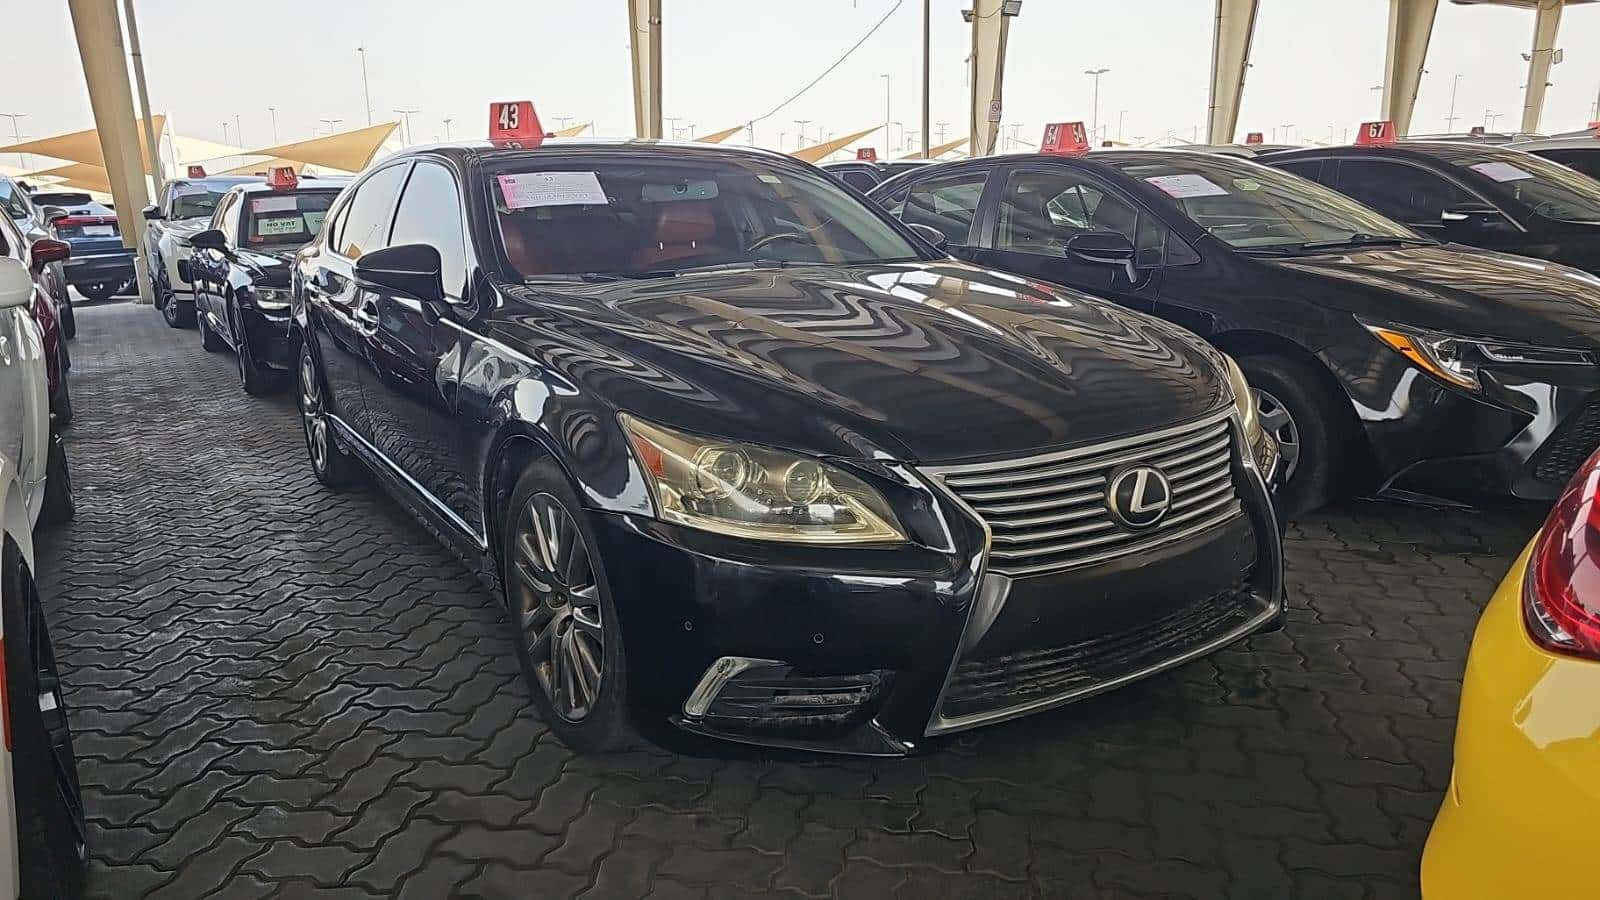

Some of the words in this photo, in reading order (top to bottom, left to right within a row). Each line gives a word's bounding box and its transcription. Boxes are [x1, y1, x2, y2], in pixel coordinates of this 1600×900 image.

[499, 103, 520, 130] 43
[1046, 125, 1060, 145] 54
[1071, 123, 1084, 144] 54
[1369, 122, 1385, 138] 67
